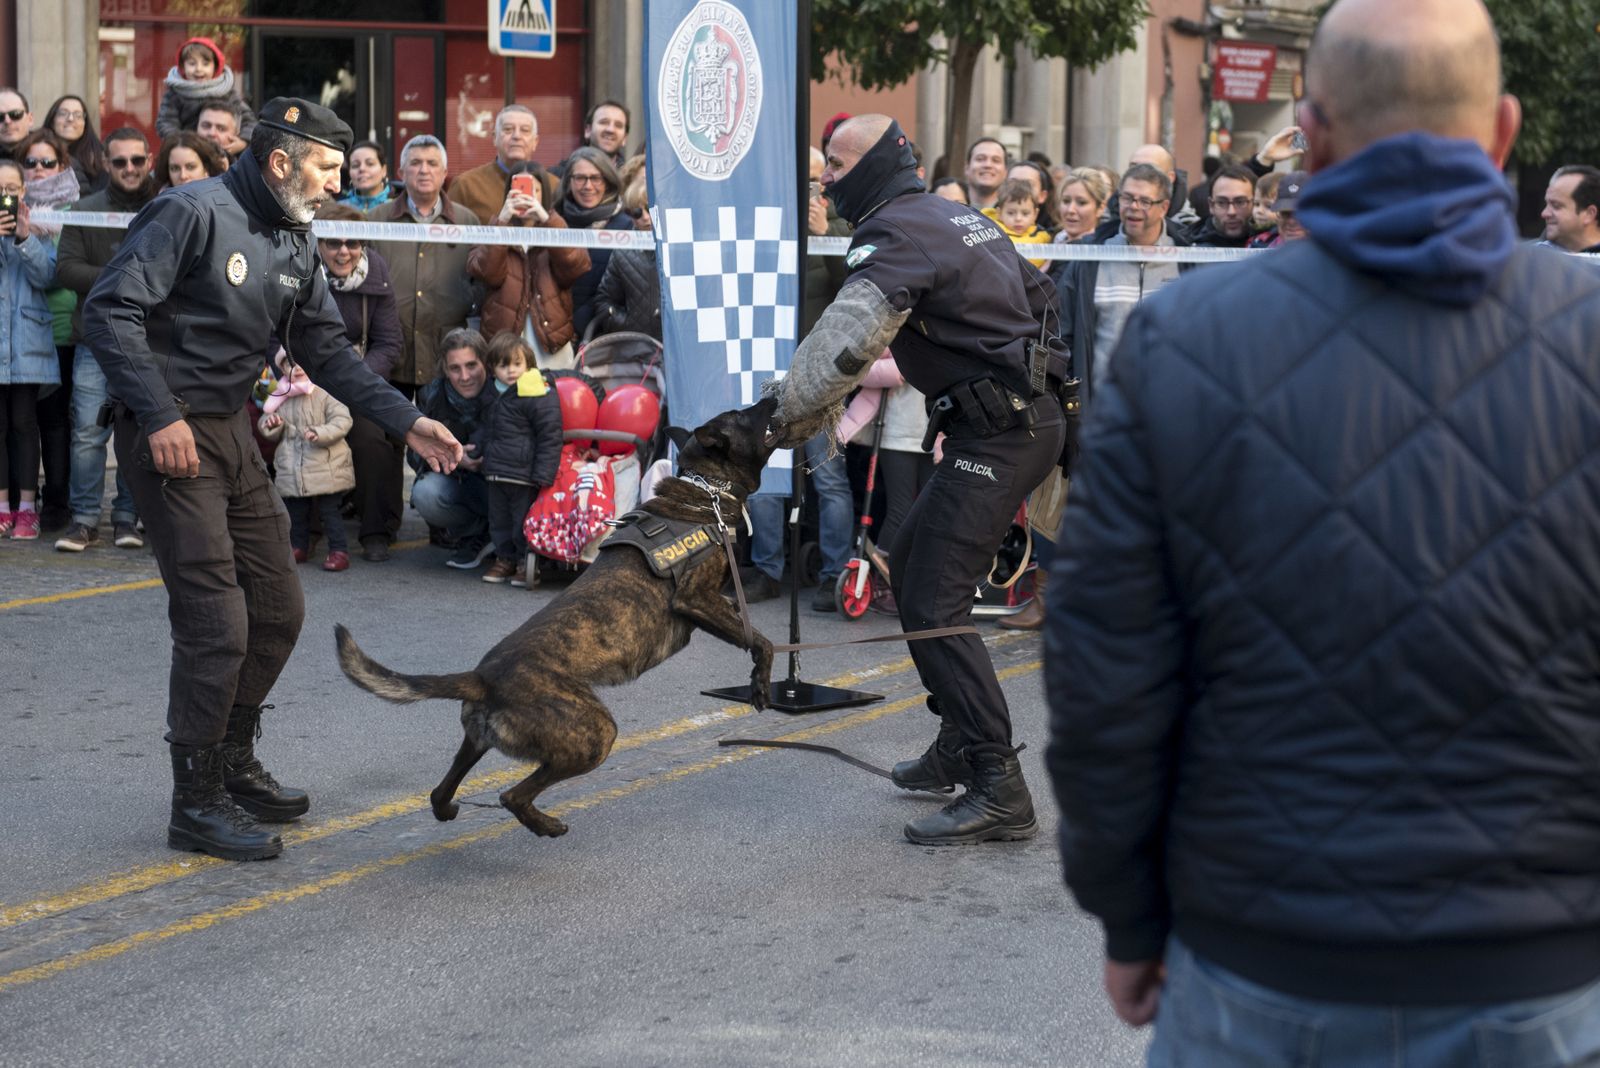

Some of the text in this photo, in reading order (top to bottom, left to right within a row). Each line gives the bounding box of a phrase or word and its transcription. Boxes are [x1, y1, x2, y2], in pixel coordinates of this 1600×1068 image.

[962, 227, 1002, 247] GRANADA
[953, 458, 993, 478] POLICIA
[653, 529, 710, 566] POLICIA
